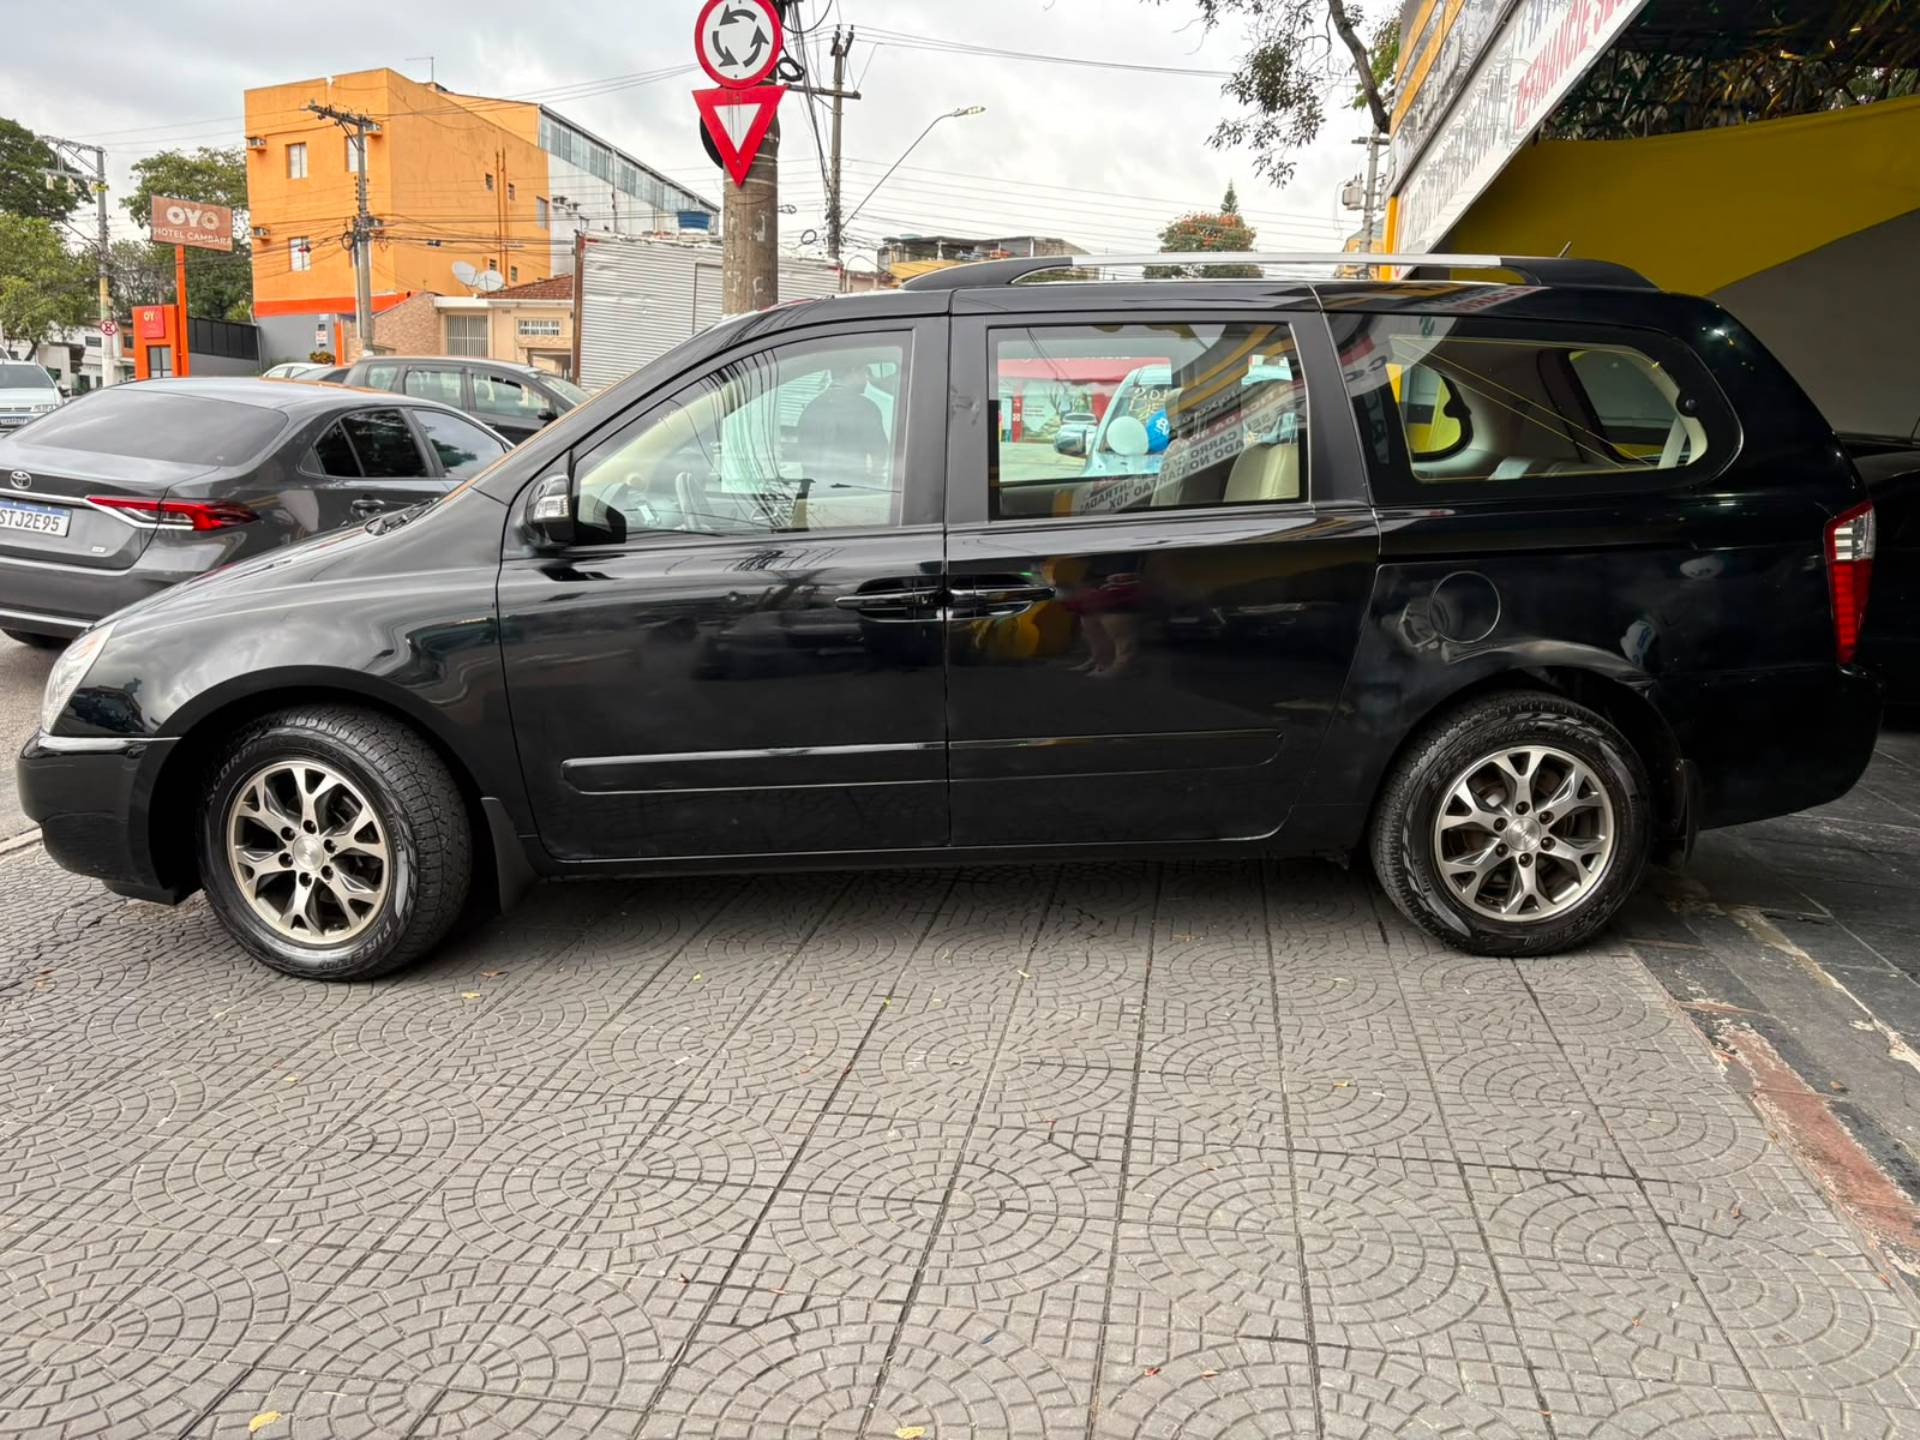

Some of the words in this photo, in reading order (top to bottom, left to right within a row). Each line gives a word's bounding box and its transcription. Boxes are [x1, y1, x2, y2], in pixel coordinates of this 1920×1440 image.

[166, 206, 219, 231] OYO
[153, 227, 185, 239] HOTEL
[0, 508, 61, 532] STJ2E95
